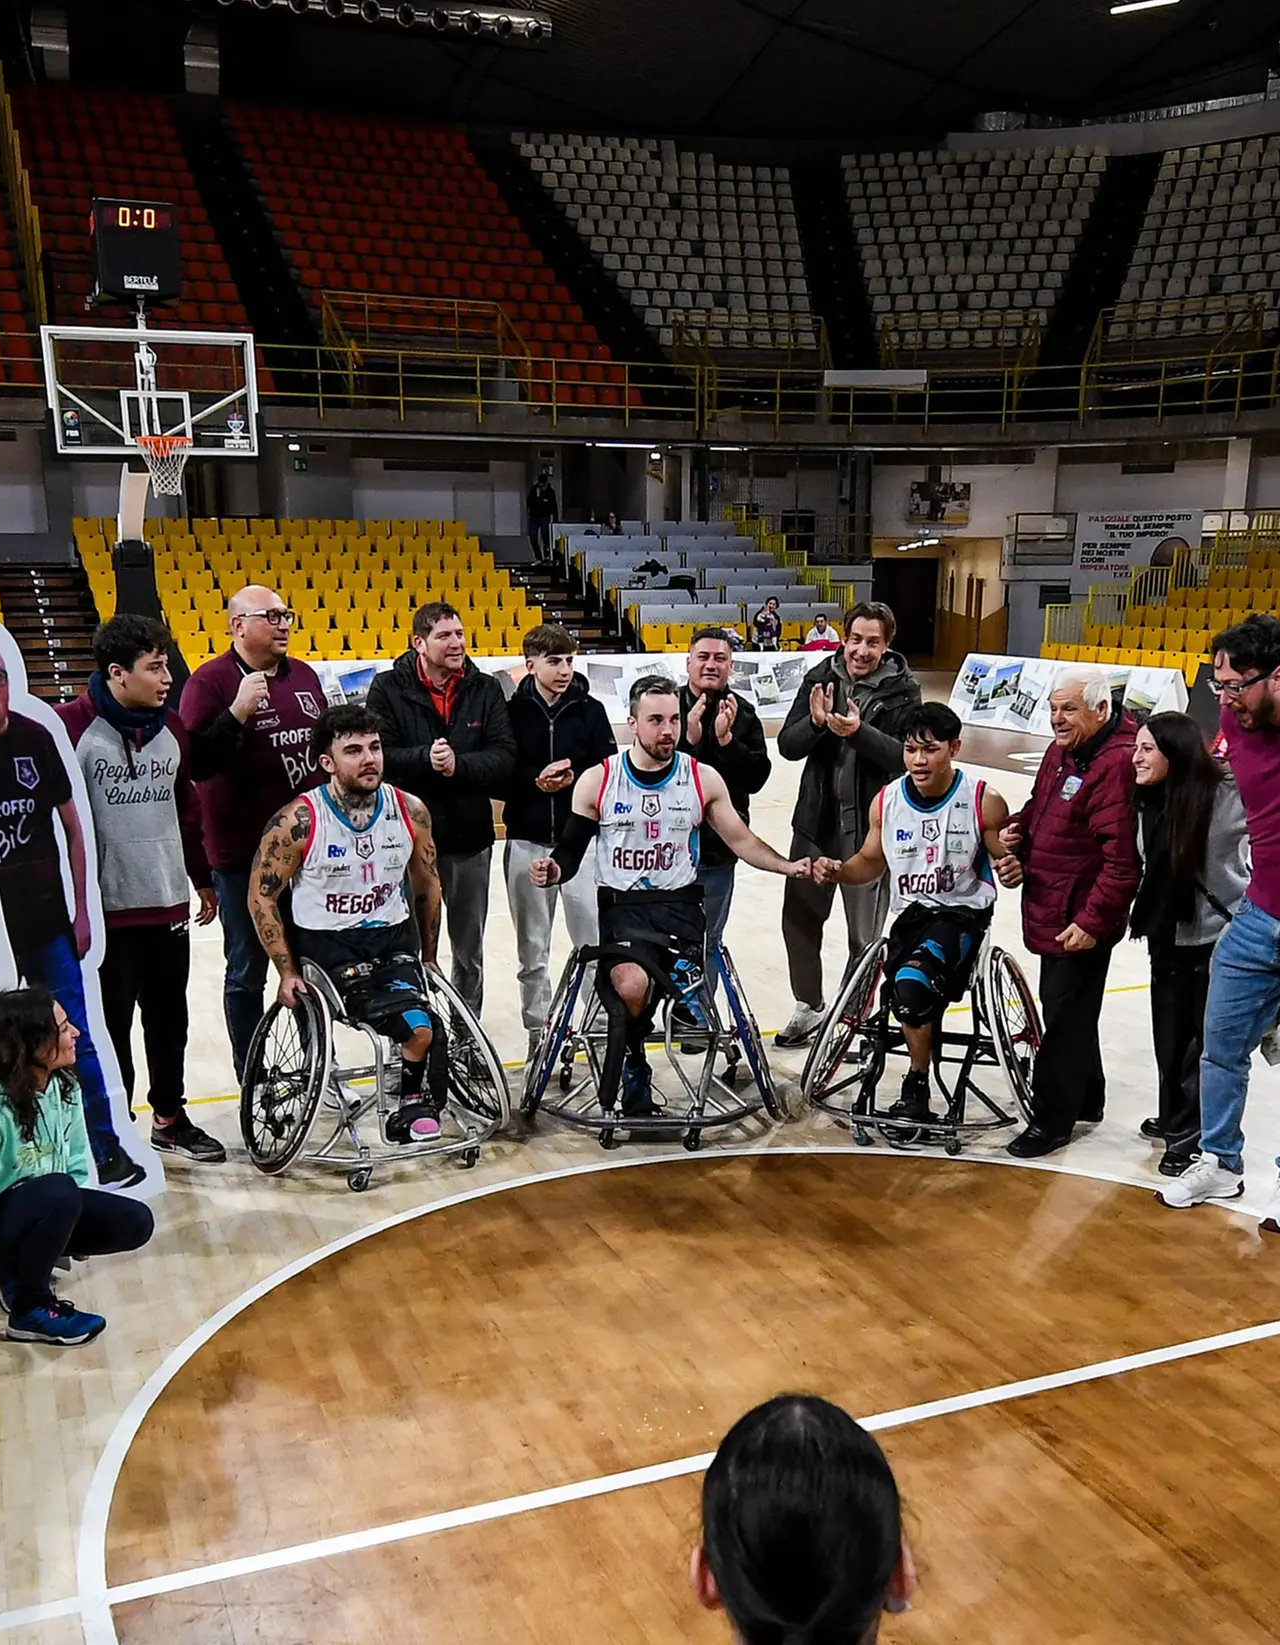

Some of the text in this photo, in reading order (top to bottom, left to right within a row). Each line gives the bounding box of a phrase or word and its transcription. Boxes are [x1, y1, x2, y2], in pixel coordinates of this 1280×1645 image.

[119, 206, 156, 229] 0:0
[1132, 514, 1164, 522] QUESTO
[269, 727, 312, 748] TROFE
[150, 757, 175, 779] BiC
[105, 786, 172, 805] Calabria
[644, 821, 660, 839] 15
[361, 862, 376, 883] 11
